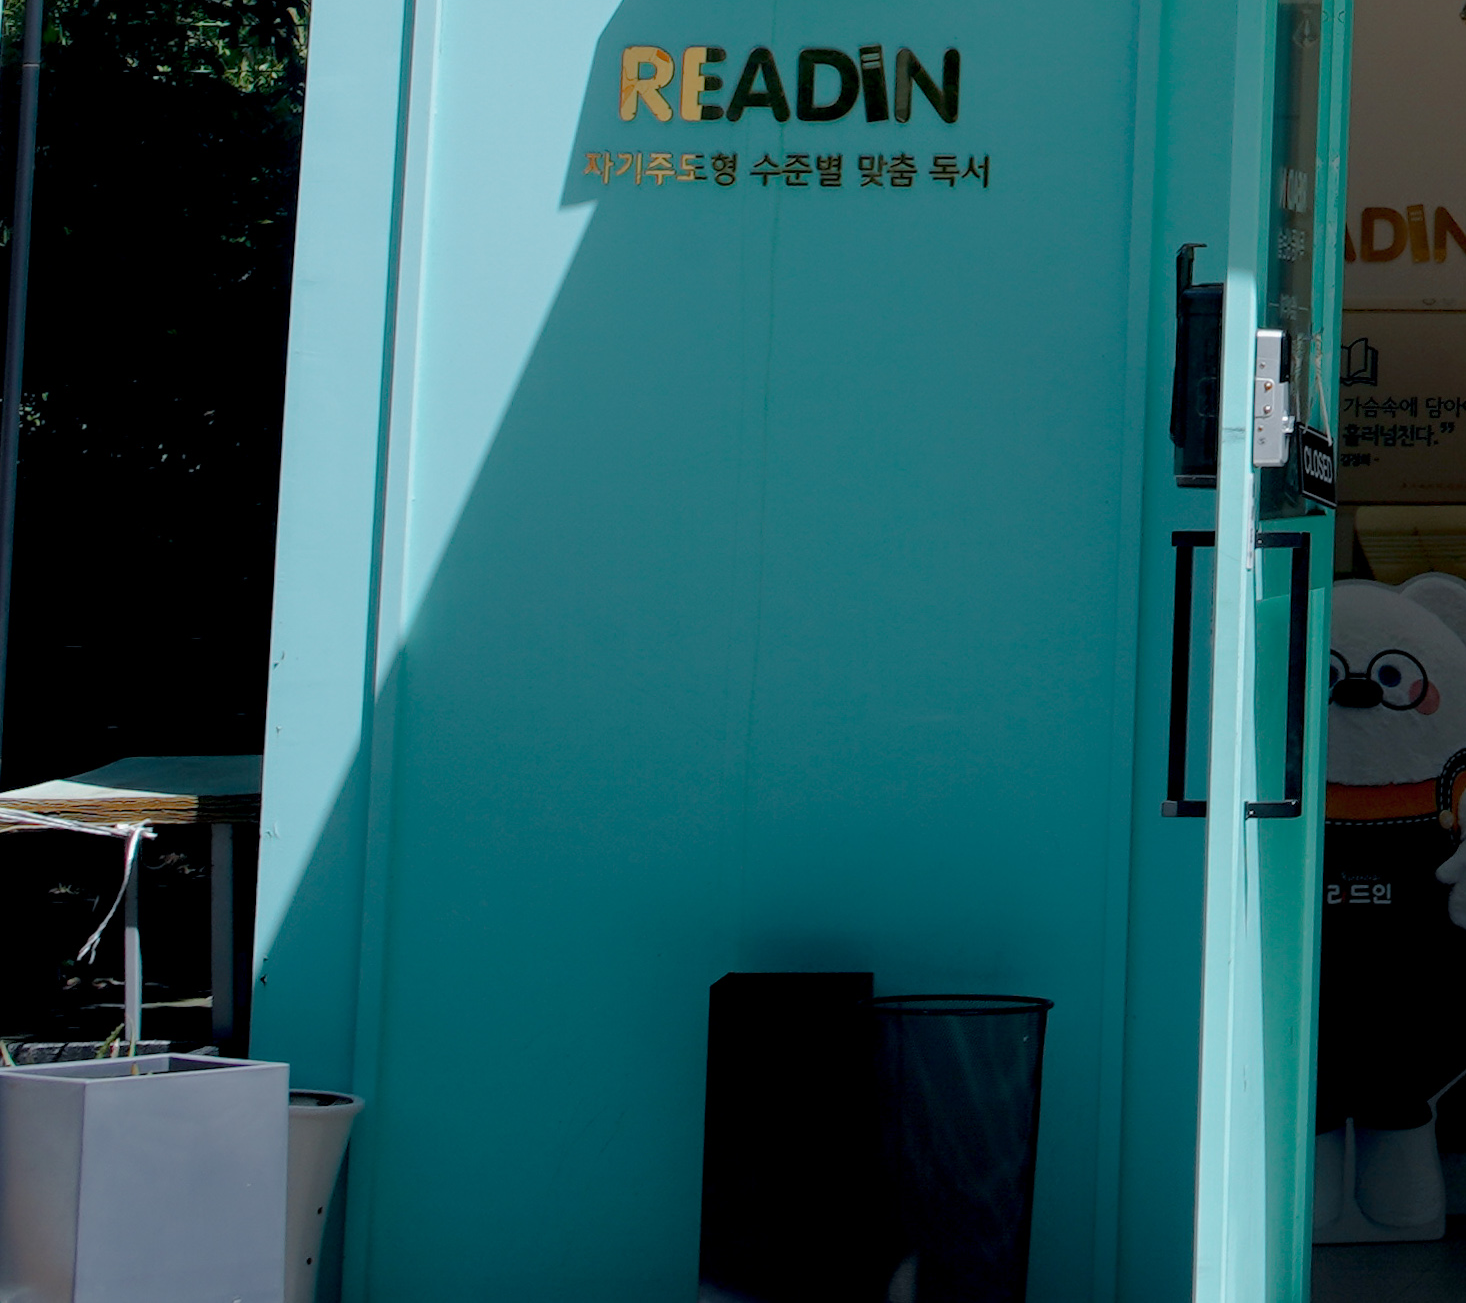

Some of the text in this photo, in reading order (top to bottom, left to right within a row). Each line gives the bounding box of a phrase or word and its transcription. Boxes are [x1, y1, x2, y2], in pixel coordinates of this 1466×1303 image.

[583, 151, 991, 189] 자기주도형 수준별 맞춤 독서
[1344, 396, 1417, 418] 가슴속에
[1304, 445, 1333, 484] CLOSED
[1327, 883, 1391, 905] 리드인
